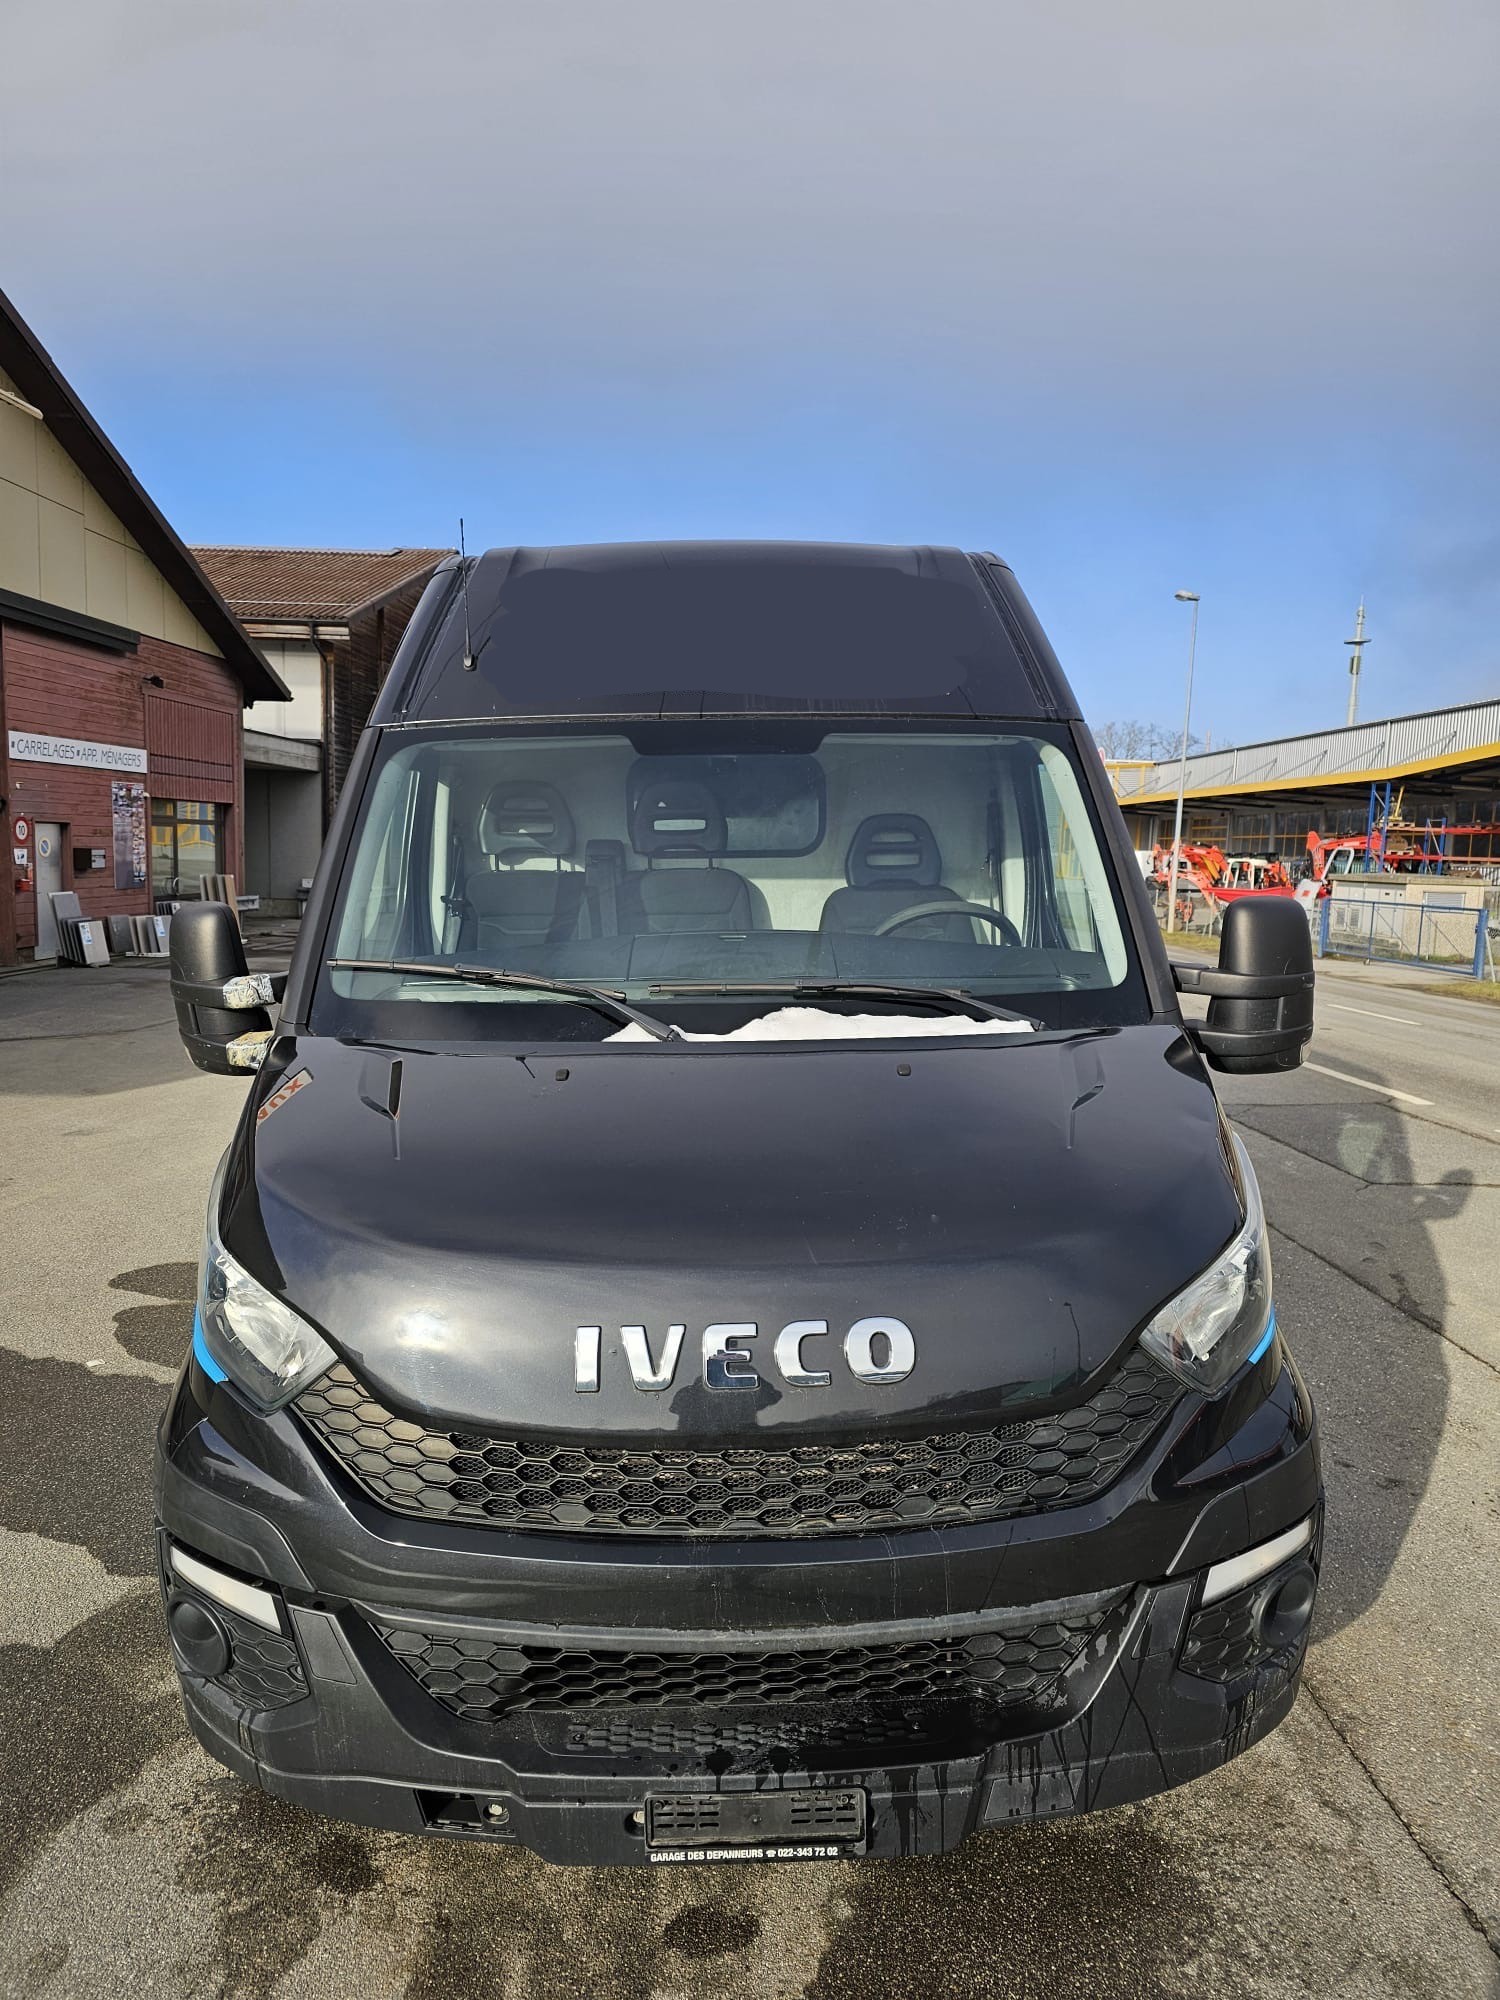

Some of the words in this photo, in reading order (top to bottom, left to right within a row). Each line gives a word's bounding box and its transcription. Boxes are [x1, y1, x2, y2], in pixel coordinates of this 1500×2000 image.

[16, 738, 75, 760] CARRELAGES
[101, 747, 142, 768] MÉNAGERS
[574, 1315, 916, 1392] IVECO
[650, 1852, 686, 1862] GARAGE
[687, 1852, 705, 1861] DES
[706, 1849, 764, 1860] DEPANNEURS
[777, 1848, 813, 1858] 022-343
[814, 1847, 826, 1857] 72
[827, 1846, 838, 1856] 02
